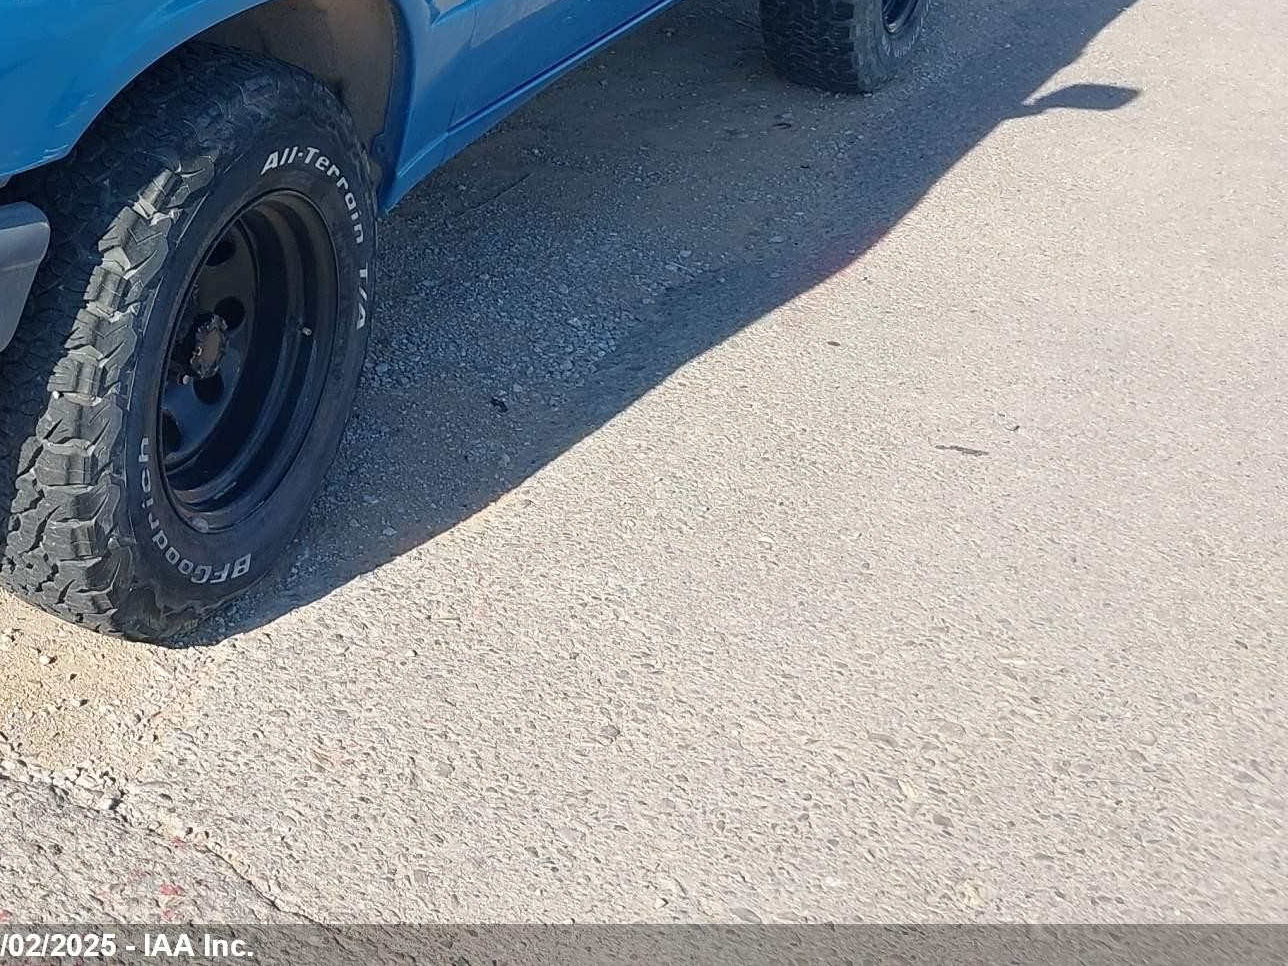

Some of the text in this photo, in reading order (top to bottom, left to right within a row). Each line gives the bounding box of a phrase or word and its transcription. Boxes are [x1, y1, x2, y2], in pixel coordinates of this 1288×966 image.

[261, 145, 369, 331] All-Terrain T/A
[138, 436, 252, 584] BFGoodrich
